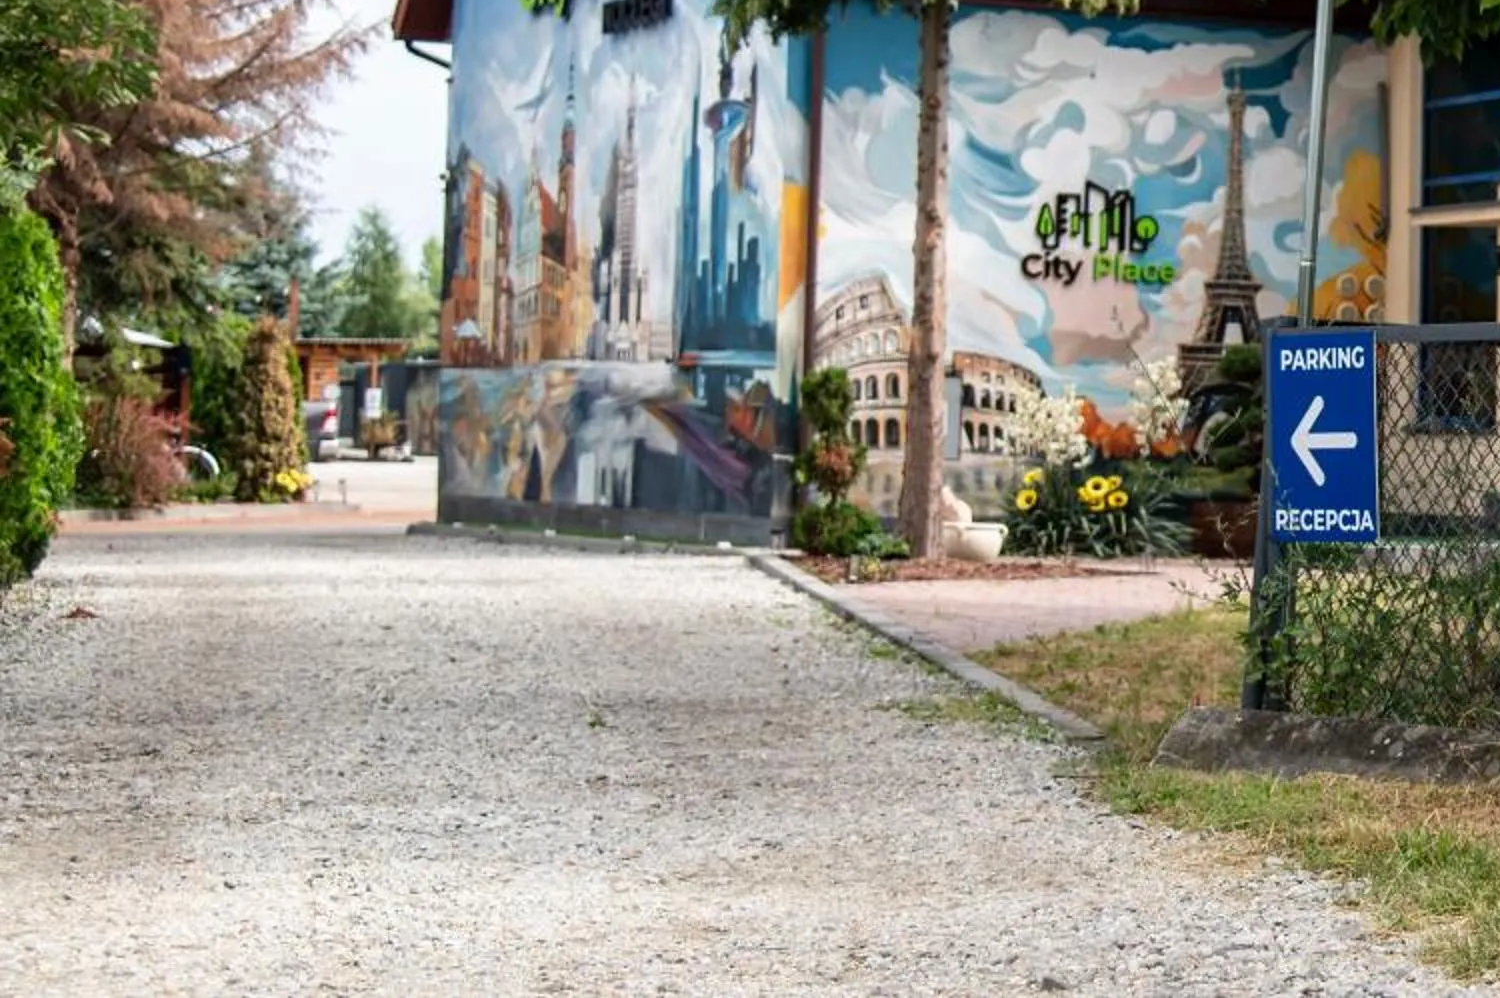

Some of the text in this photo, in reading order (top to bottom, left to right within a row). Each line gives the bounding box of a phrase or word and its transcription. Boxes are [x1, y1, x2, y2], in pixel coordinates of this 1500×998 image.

[1021, 254, 1176, 287] City Place
[1280, 346, 1365, 371] PARKING
[1275, 509, 1375, 532] RECEPCJA
